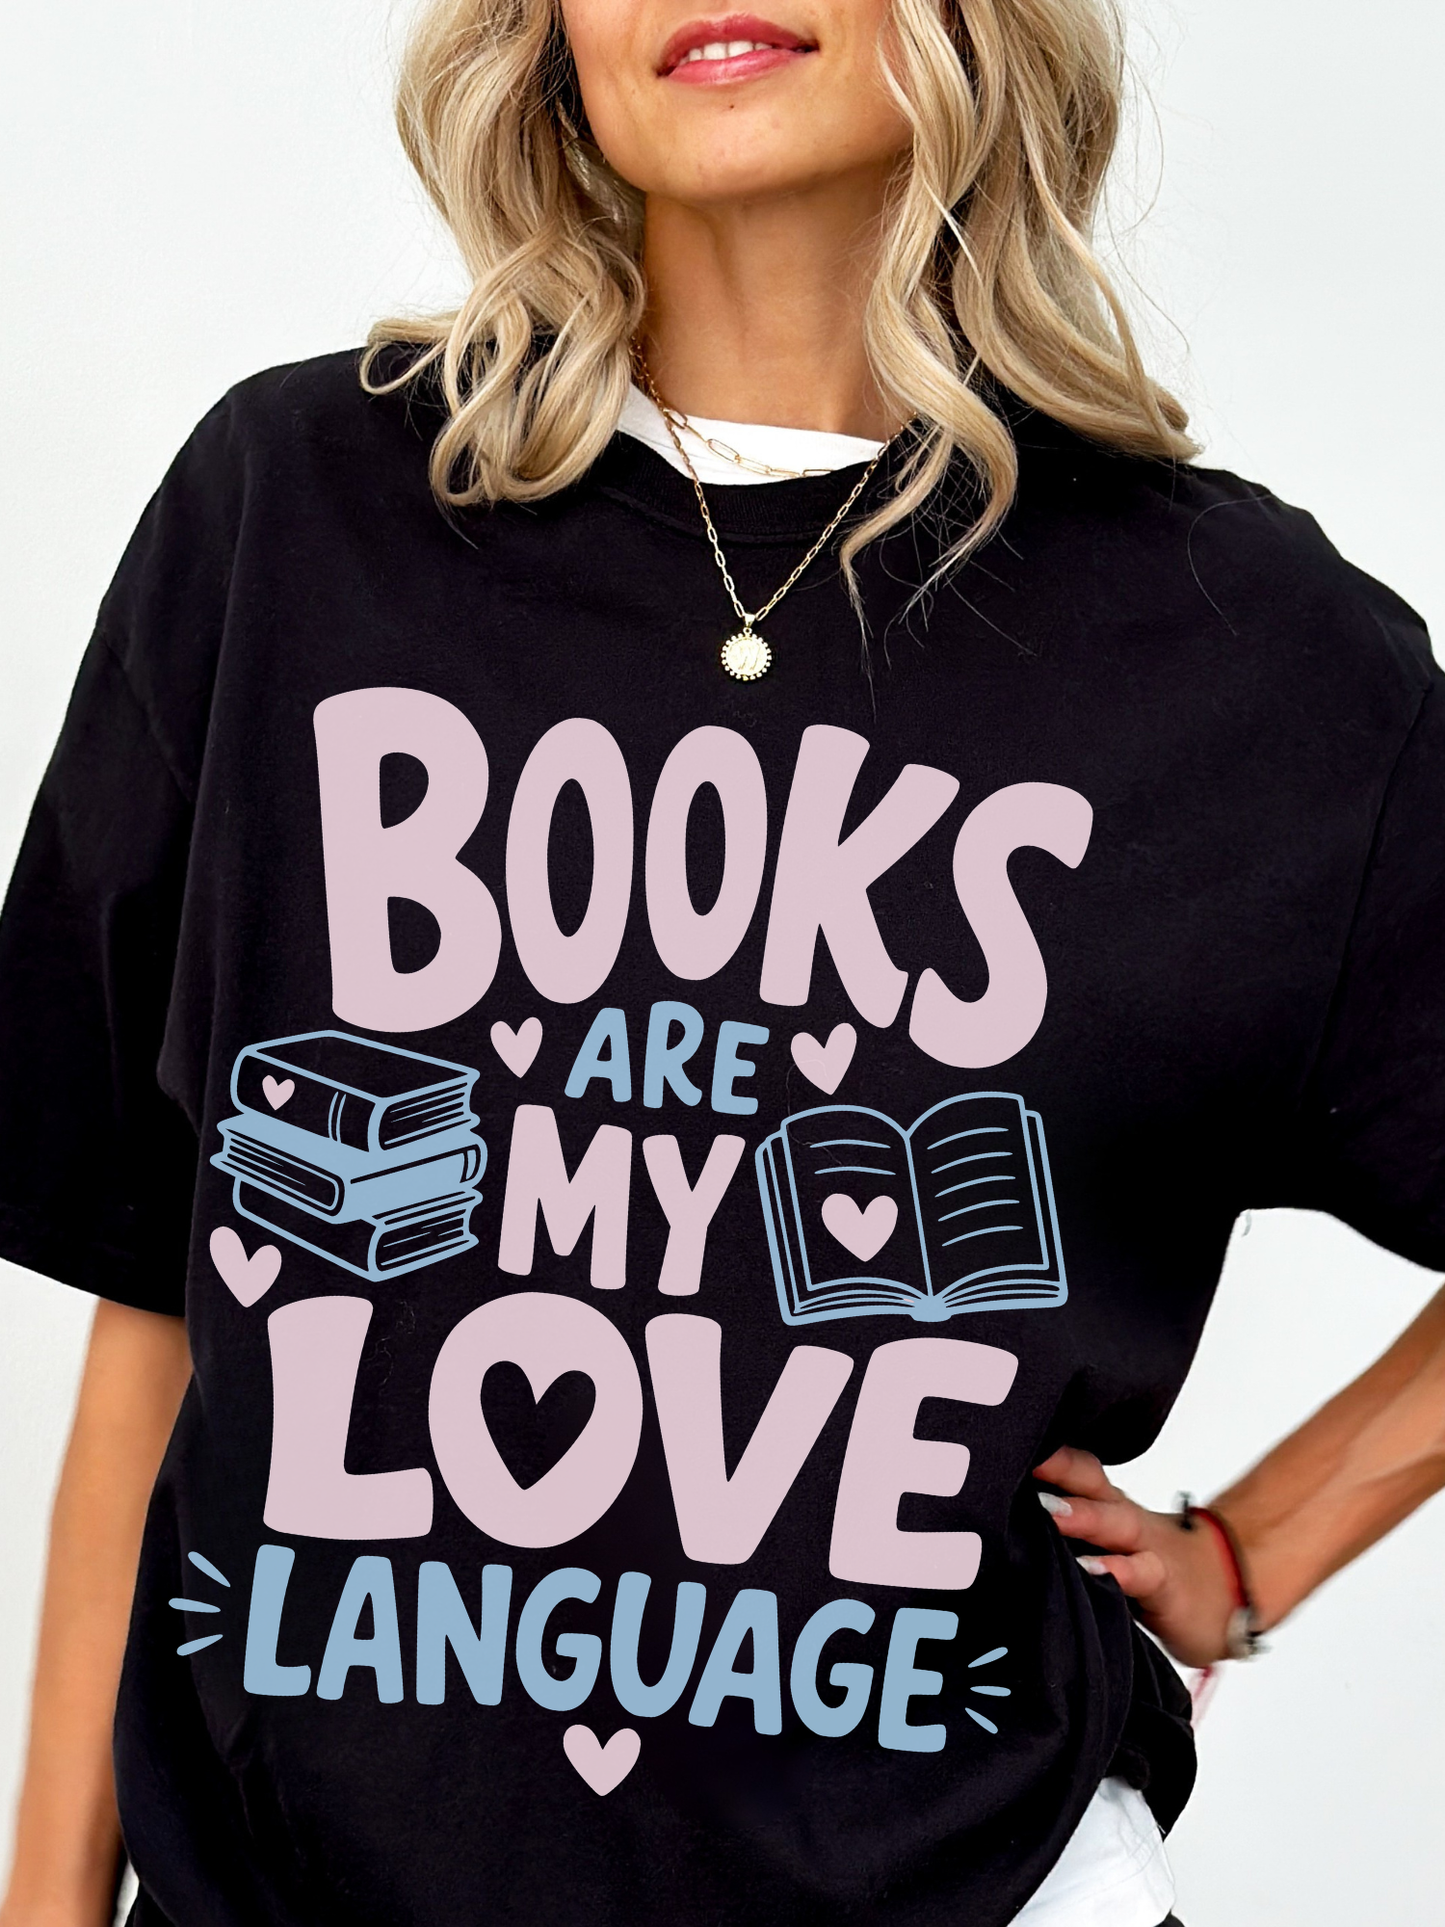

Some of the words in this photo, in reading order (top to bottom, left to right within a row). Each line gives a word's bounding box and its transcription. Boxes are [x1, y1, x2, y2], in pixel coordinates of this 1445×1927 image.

[313, 686, 1094, 1069] BOOKS
[564, 1000, 770, 1115] ARE
[497, 1104, 746, 1297] MY
[262, 1291, 1019, 1591] LOVE
[243, 1544, 959, 1753] LANGUAGE
